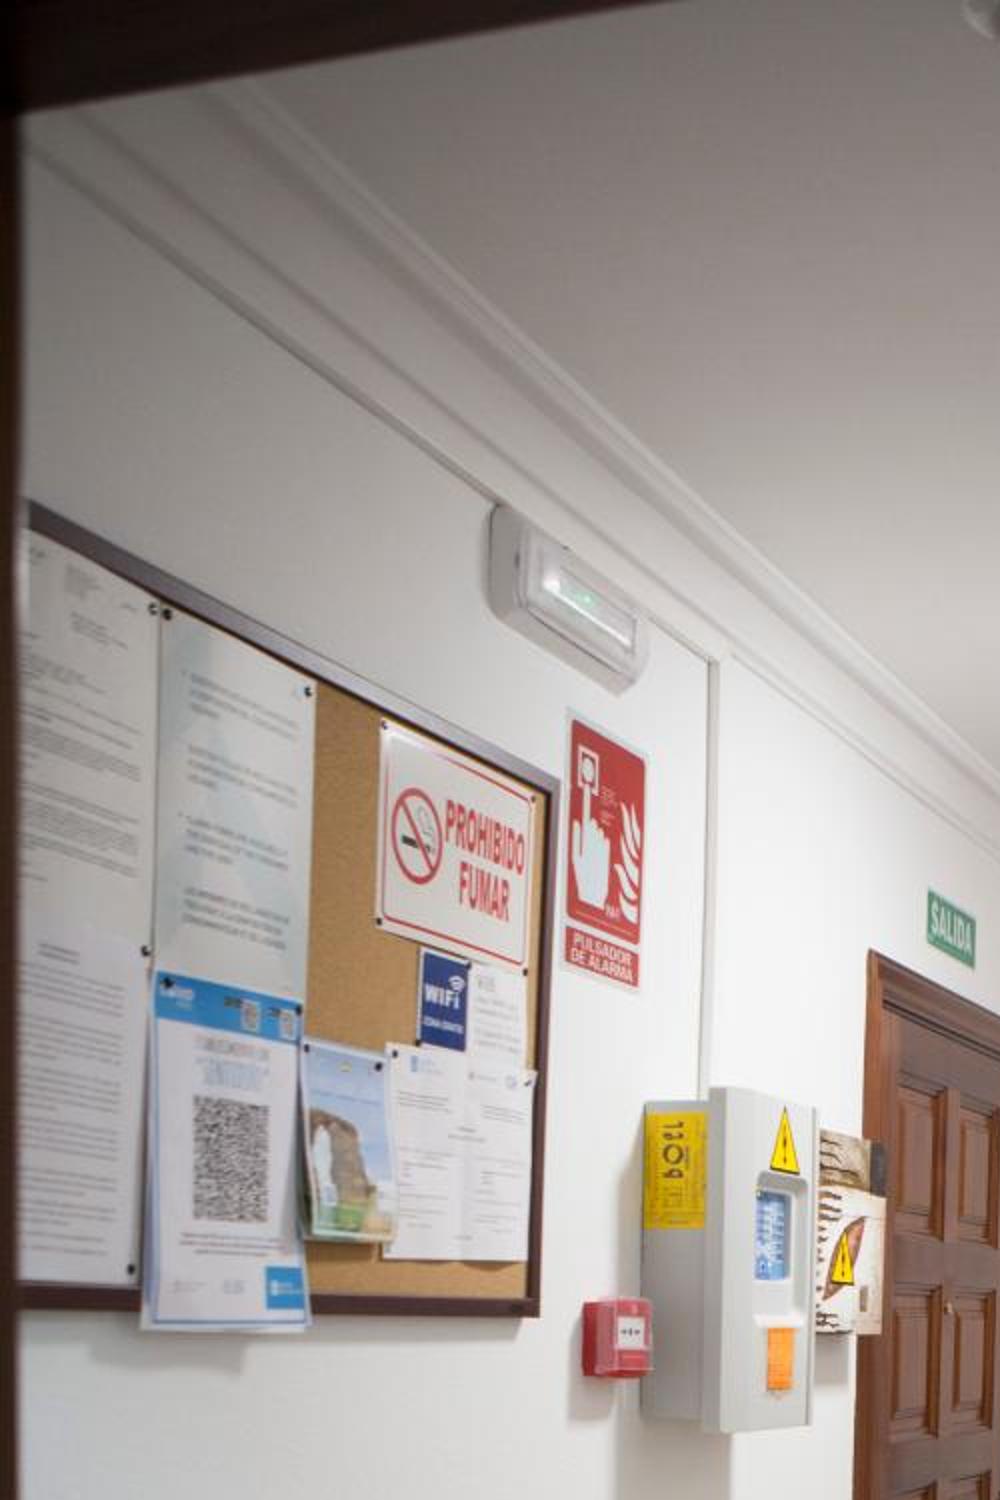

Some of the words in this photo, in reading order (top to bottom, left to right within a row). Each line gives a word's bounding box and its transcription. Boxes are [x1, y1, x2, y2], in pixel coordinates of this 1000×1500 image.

[445, 798, 525, 876] PROHIBIDO
[459, 860, 509, 922] FUMAR
[574, 931, 634, 967] PULSADOR
[930, 899, 972, 956] SALIDA
